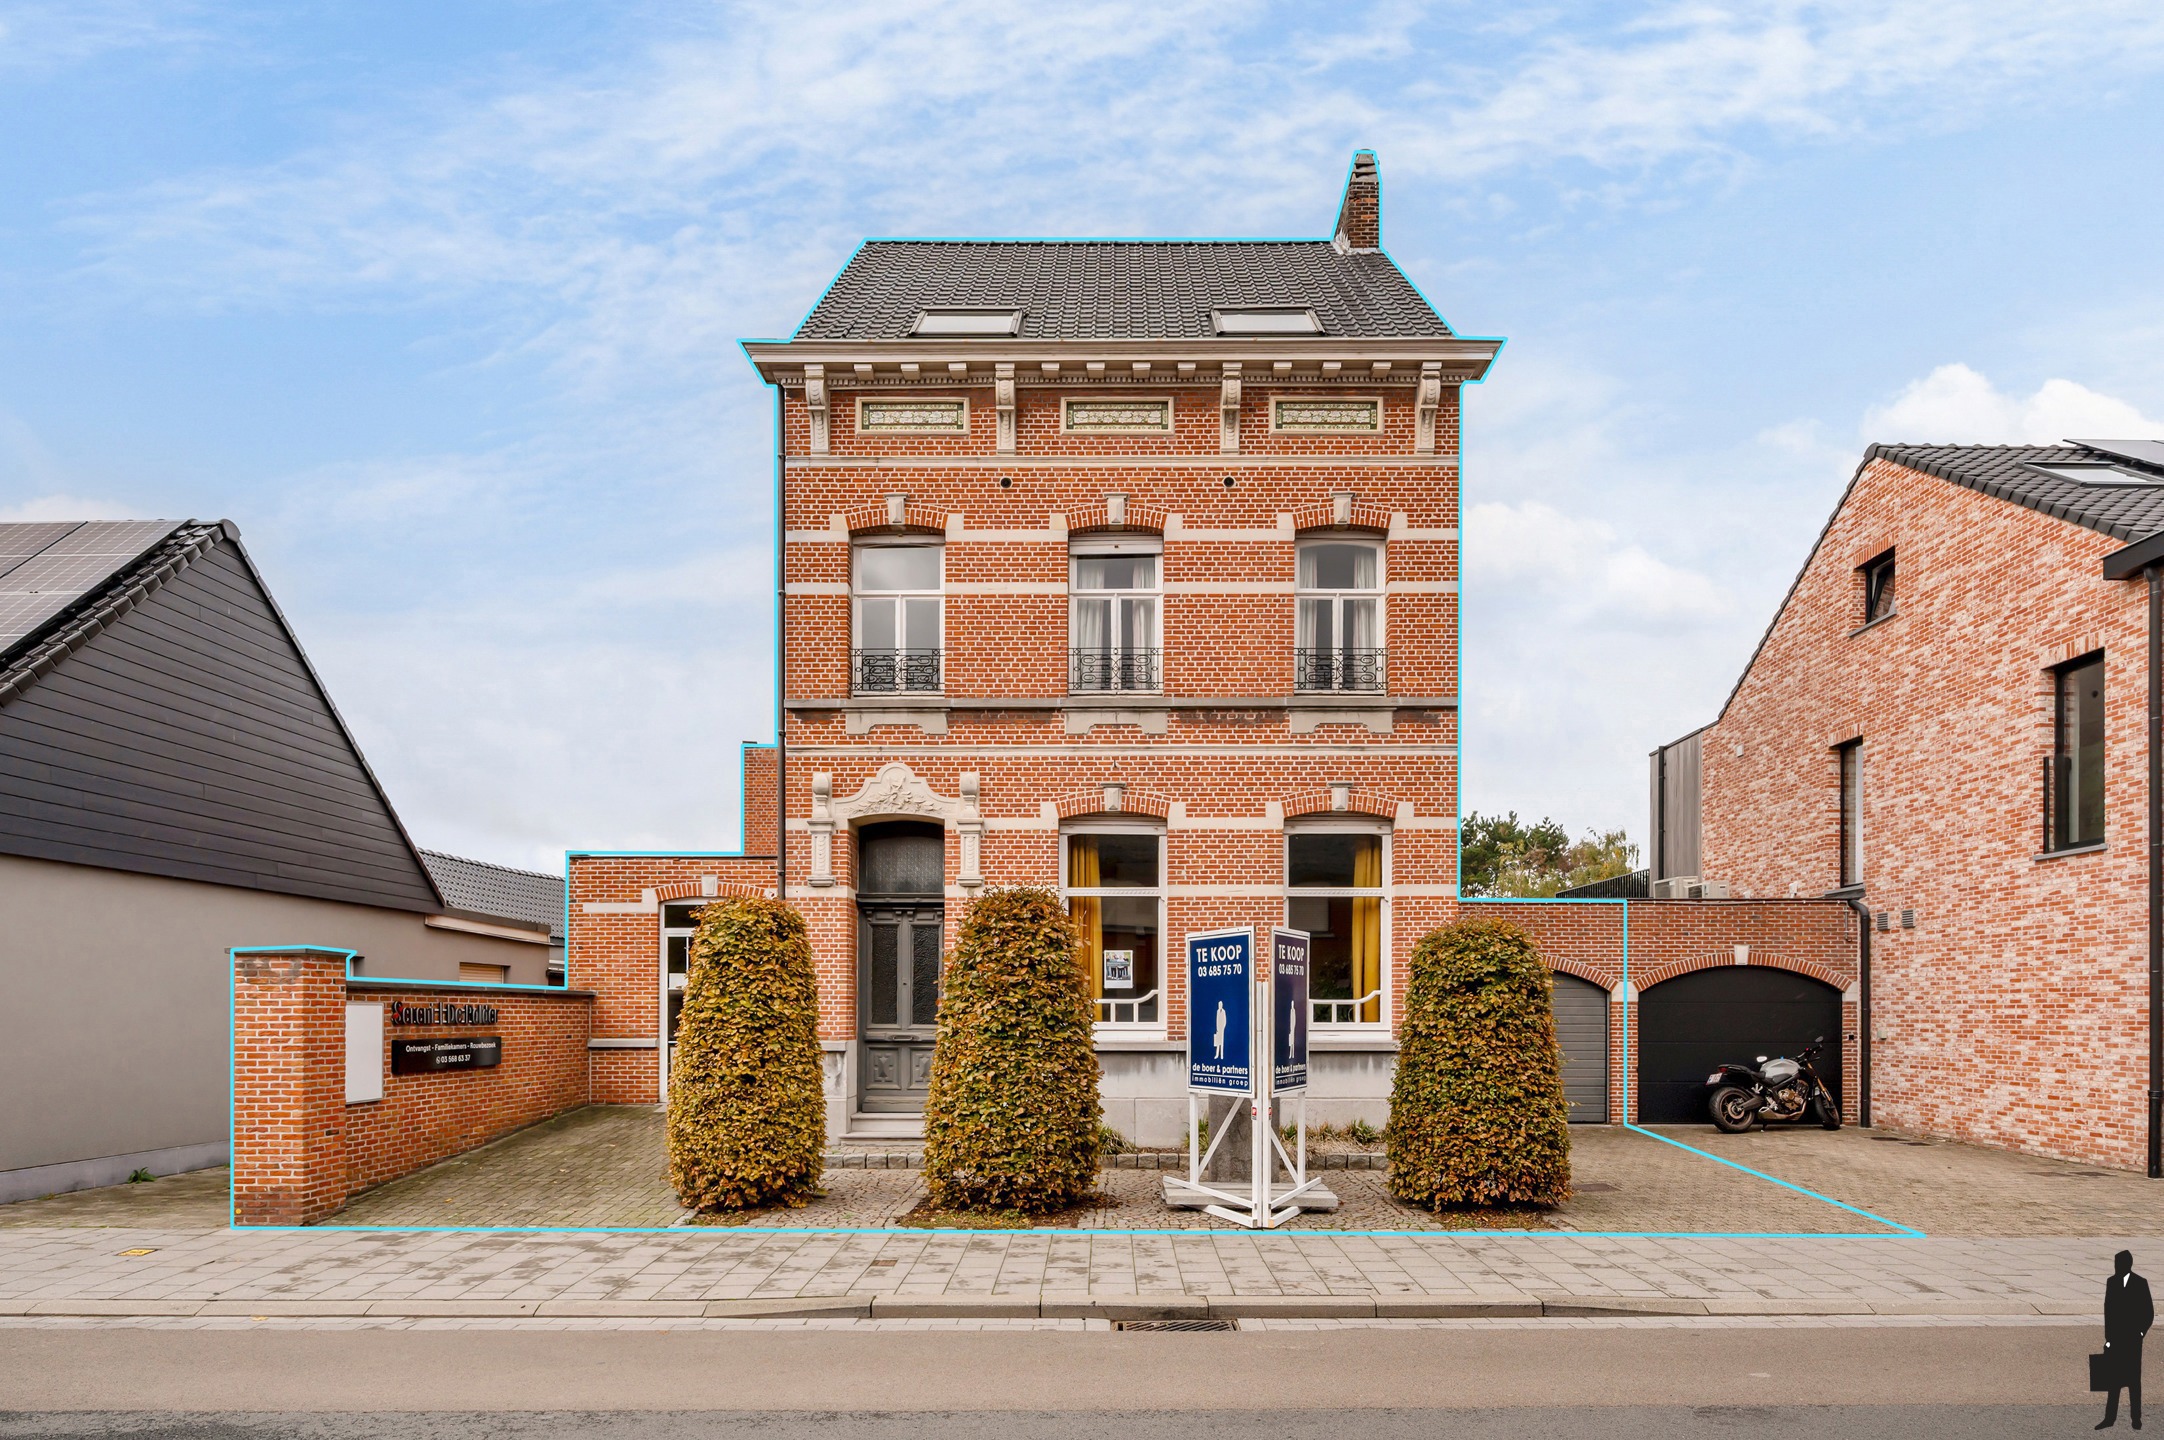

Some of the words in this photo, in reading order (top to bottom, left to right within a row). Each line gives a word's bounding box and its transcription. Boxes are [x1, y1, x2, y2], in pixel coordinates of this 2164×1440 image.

[1196, 947, 1208, 962] TE
[1210, 945, 1242, 961] KOOP
[1278, 944, 1286, 960] TE
[1287, 945, 1304, 961] KOOP
[1198, 966, 1207, 977] 03
[1208, 965, 1221, 976] 685
[1223, 964, 1232, 975] 75
[1233, 963, 1242, 975] 70
[1278, 963, 1285, 975] 03
[1285, 964, 1293, 975] 685
[1294, 964, 1299, 976] 75
[1299, 965, 1304, 976] 70
[405, 1045, 431, 1053] Ontvangst
[1192, 1063, 1201, 1072] de
[1201, 1063, 1215, 1072] boer
[1216, 1064, 1221, 1073] &
[1222, 1065, 1248, 1075] partners
[1228, 1079, 1249, 1087] groep
